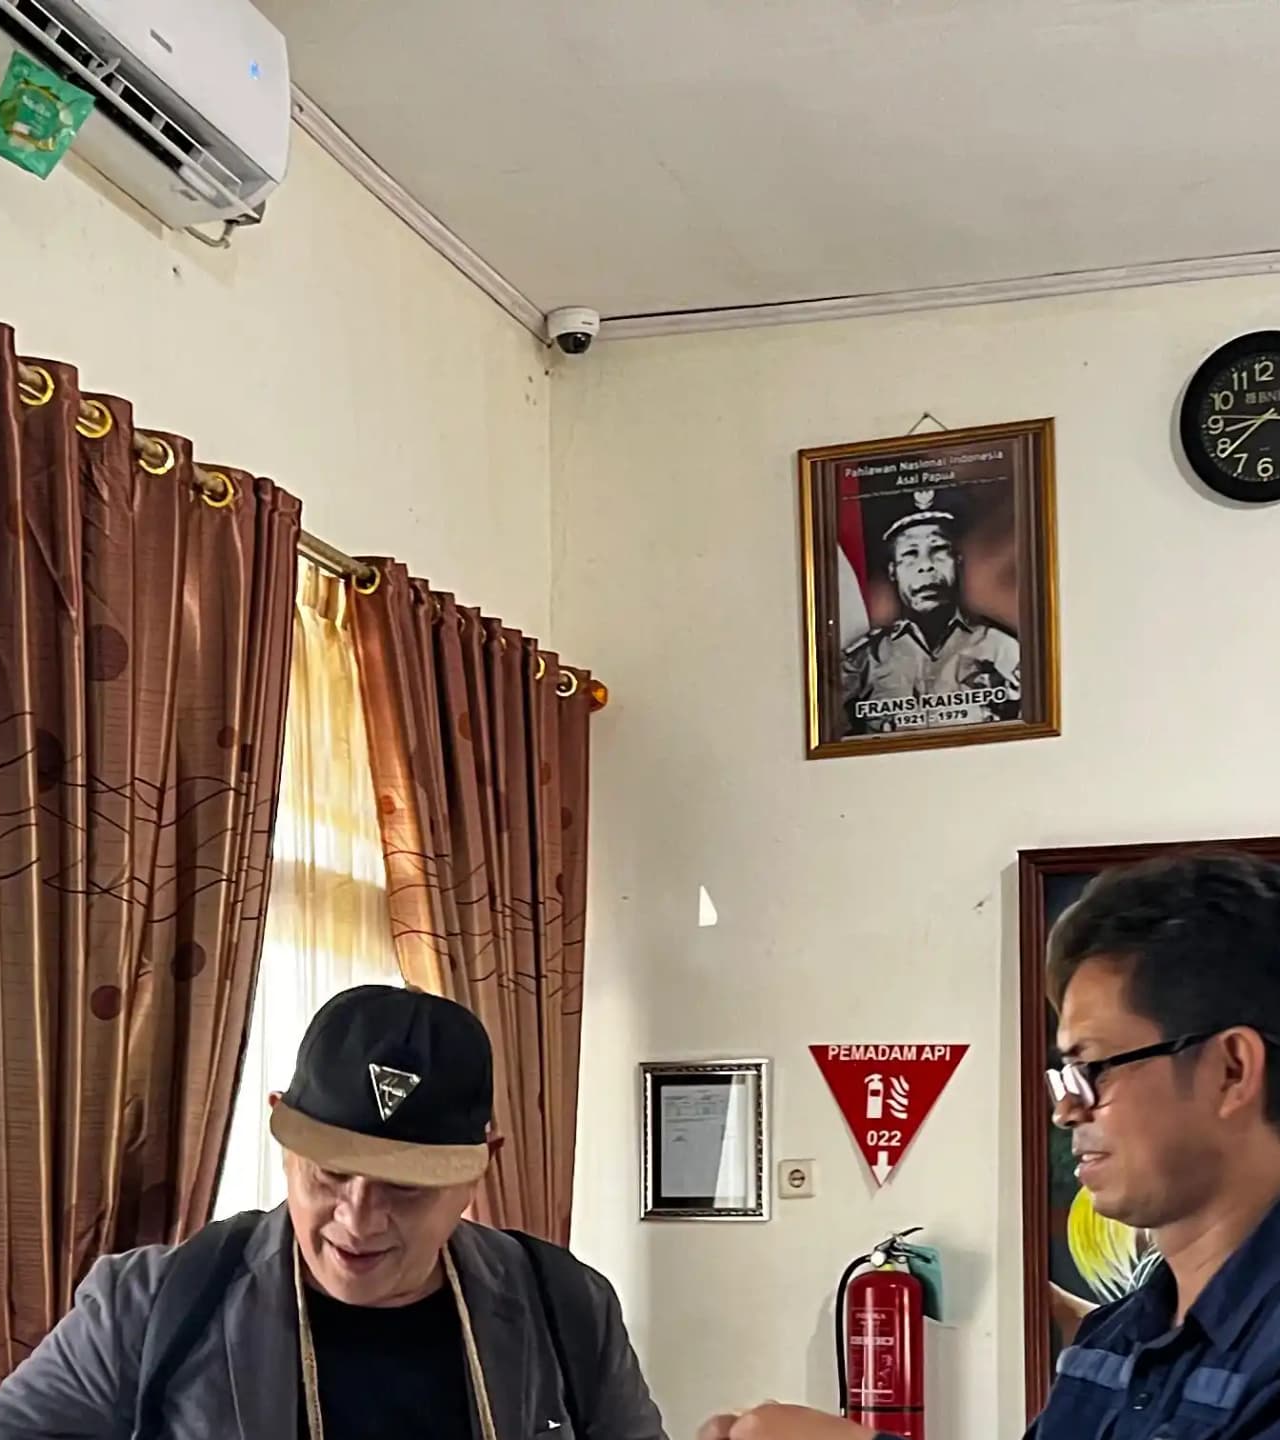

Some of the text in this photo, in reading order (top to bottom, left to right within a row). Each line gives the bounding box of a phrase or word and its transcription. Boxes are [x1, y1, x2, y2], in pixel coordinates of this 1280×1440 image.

[1231, 371, 1248, 391] 11
[1254, 361, 1274, 382] 12
[1209, 390, 1234, 411] 10
[1207, 415, 1225, 434] 9
[1216, 438, 1231, 458] 8
[844, 450, 1004, 478] Pahlawan Nasional Indonesia
[1233, 453, 1248, 474] 7
[1256, 457, 1274, 477] 6
[896, 471, 955, 486] Asal Papua
[856, 688, 1008, 718] FRANS KAISIEPO
[895, 713, 926, 726] 1921
[938, 708, 969, 722] 1979
[827, 1045, 951, 1061] PEMADAM API
[866, 1130, 902, 1146] 022
